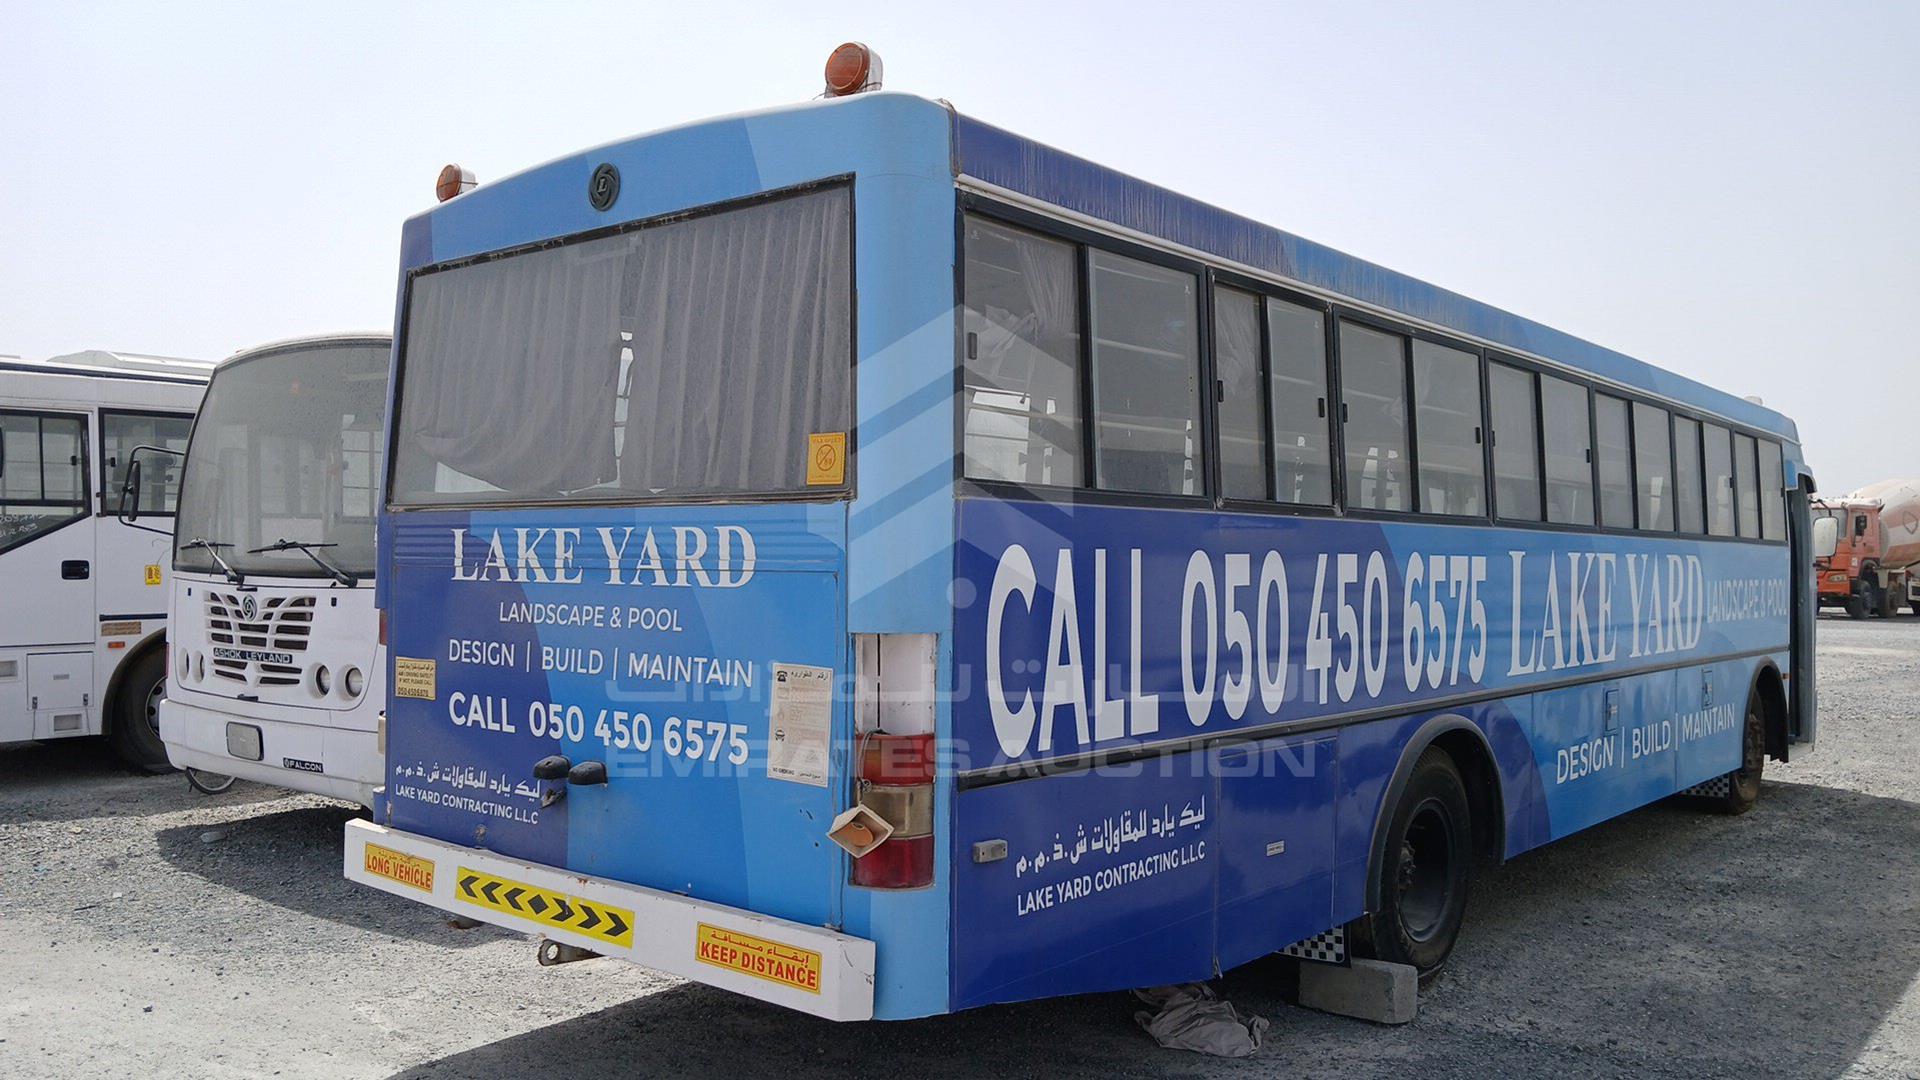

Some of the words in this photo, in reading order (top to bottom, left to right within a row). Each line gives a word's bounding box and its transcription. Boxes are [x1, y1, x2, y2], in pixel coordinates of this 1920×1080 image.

[451, 527, 584, 584] LAKE
[596, 525, 757, 588] YARD
[500, 601, 604, 627] LANDSCAPE
[610, 607, 622, 628] &
[628, 608, 682, 631] POOL
[1507, 550, 1617, 676] LAKE
[1625, 551, 1703, 658] YARD
[1707, 578, 1760, 623] LANDSCAPE
[214, 648, 242, 659] ASHOK
[246, 651, 291, 664] LEYLAND
[449, 638, 515, 667] DESIGN
[542, 646, 603, 675] BUILD
[628, 653, 752, 688] MAINTAIN
[986, 543, 1160, 758] CALL
[1181, 549, 1290, 727] 050
[1305, 550, 1389, 704] 450
[1403, 551, 1487, 692] 6575
[449, 691, 516, 733] CALL
[529, 701, 584, 743] 050
[594, 709, 653, 752] 450
[663, 716, 749, 765] 6575
[1557, 735, 1615, 785] DESIGN
[1632, 720, 1671, 760] BUILD
[1682, 703, 1735, 743] MAINTAIN
[290, 761, 322, 773] FALCON
[442, 764, 487, 789] للمقاولات
[489, 773, 511, 798] يارد
[395, 784, 415, 799] LAKE
[416, 788, 440, 804] YARD
[442, 795, 513, 819] CONTRACTING
[514, 807, 539, 825] L.L.C
[514, 779, 541, 802] ليك
[1091, 808, 1147, 854] للمقاولات
[1151, 803, 1175, 838] يارد
[1179, 794, 1205, 830] ليك
[367, 854, 390, 874] LONG
[393, 861, 431, 888] VEHICLE
[1017, 886, 1054, 916] LAKE
[1056, 875, 1092, 904] YARD
[1095, 848, 1179, 892] CONTRACTING
[1181, 840, 1206, 869] L.L.C
[711, 930, 763, 952] مسافة
[701, 941, 737, 964] KEEP
[741, 952, 816, 987] DISTANCE
